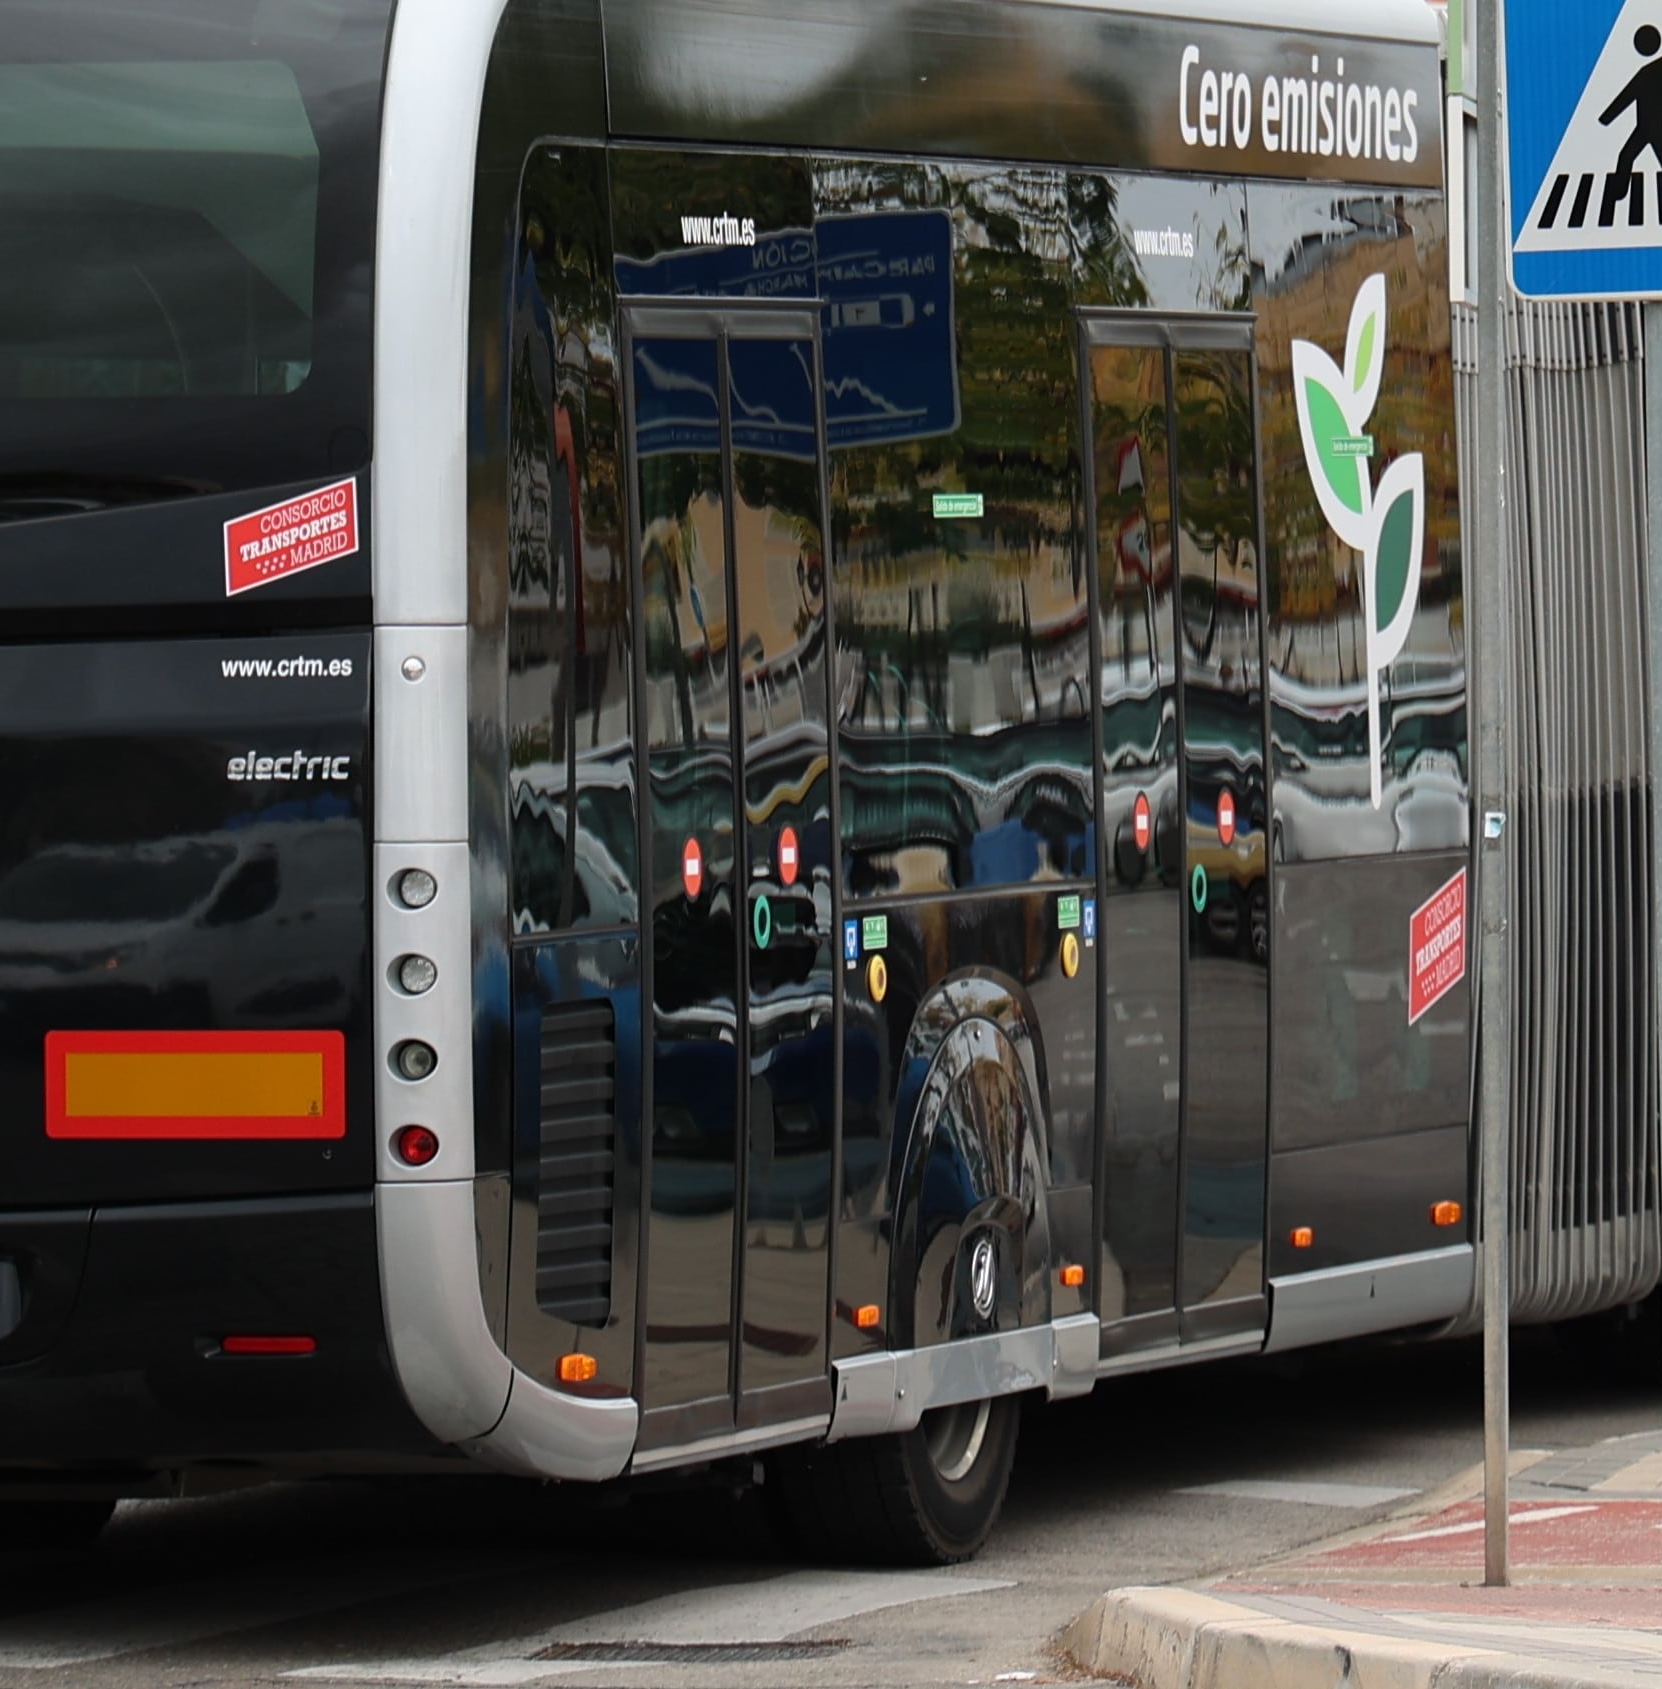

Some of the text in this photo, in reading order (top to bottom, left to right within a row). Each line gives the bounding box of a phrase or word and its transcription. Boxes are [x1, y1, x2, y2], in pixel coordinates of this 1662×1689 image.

[1180, 45, 1418, 163] Cero emisiones
[681, 212, 755, 246] www.crtm.es
[1134, 226, 1194, 258] www.crtm.es
[260, 489, 346, 533] CONSORCIO
[240, 510, 347, 562] TRANSPORTES
[290, 531, 347, 566] MADRID
[221, 655, 352, 677] www.crtm.es
[227, 750, 350, 780] electric
[1424, 883, 1461, 937] CONSORCIO
[1416, 914, 1461, 976] TRANSPORTES
[1436, 945, 1461, 989] MADRID
